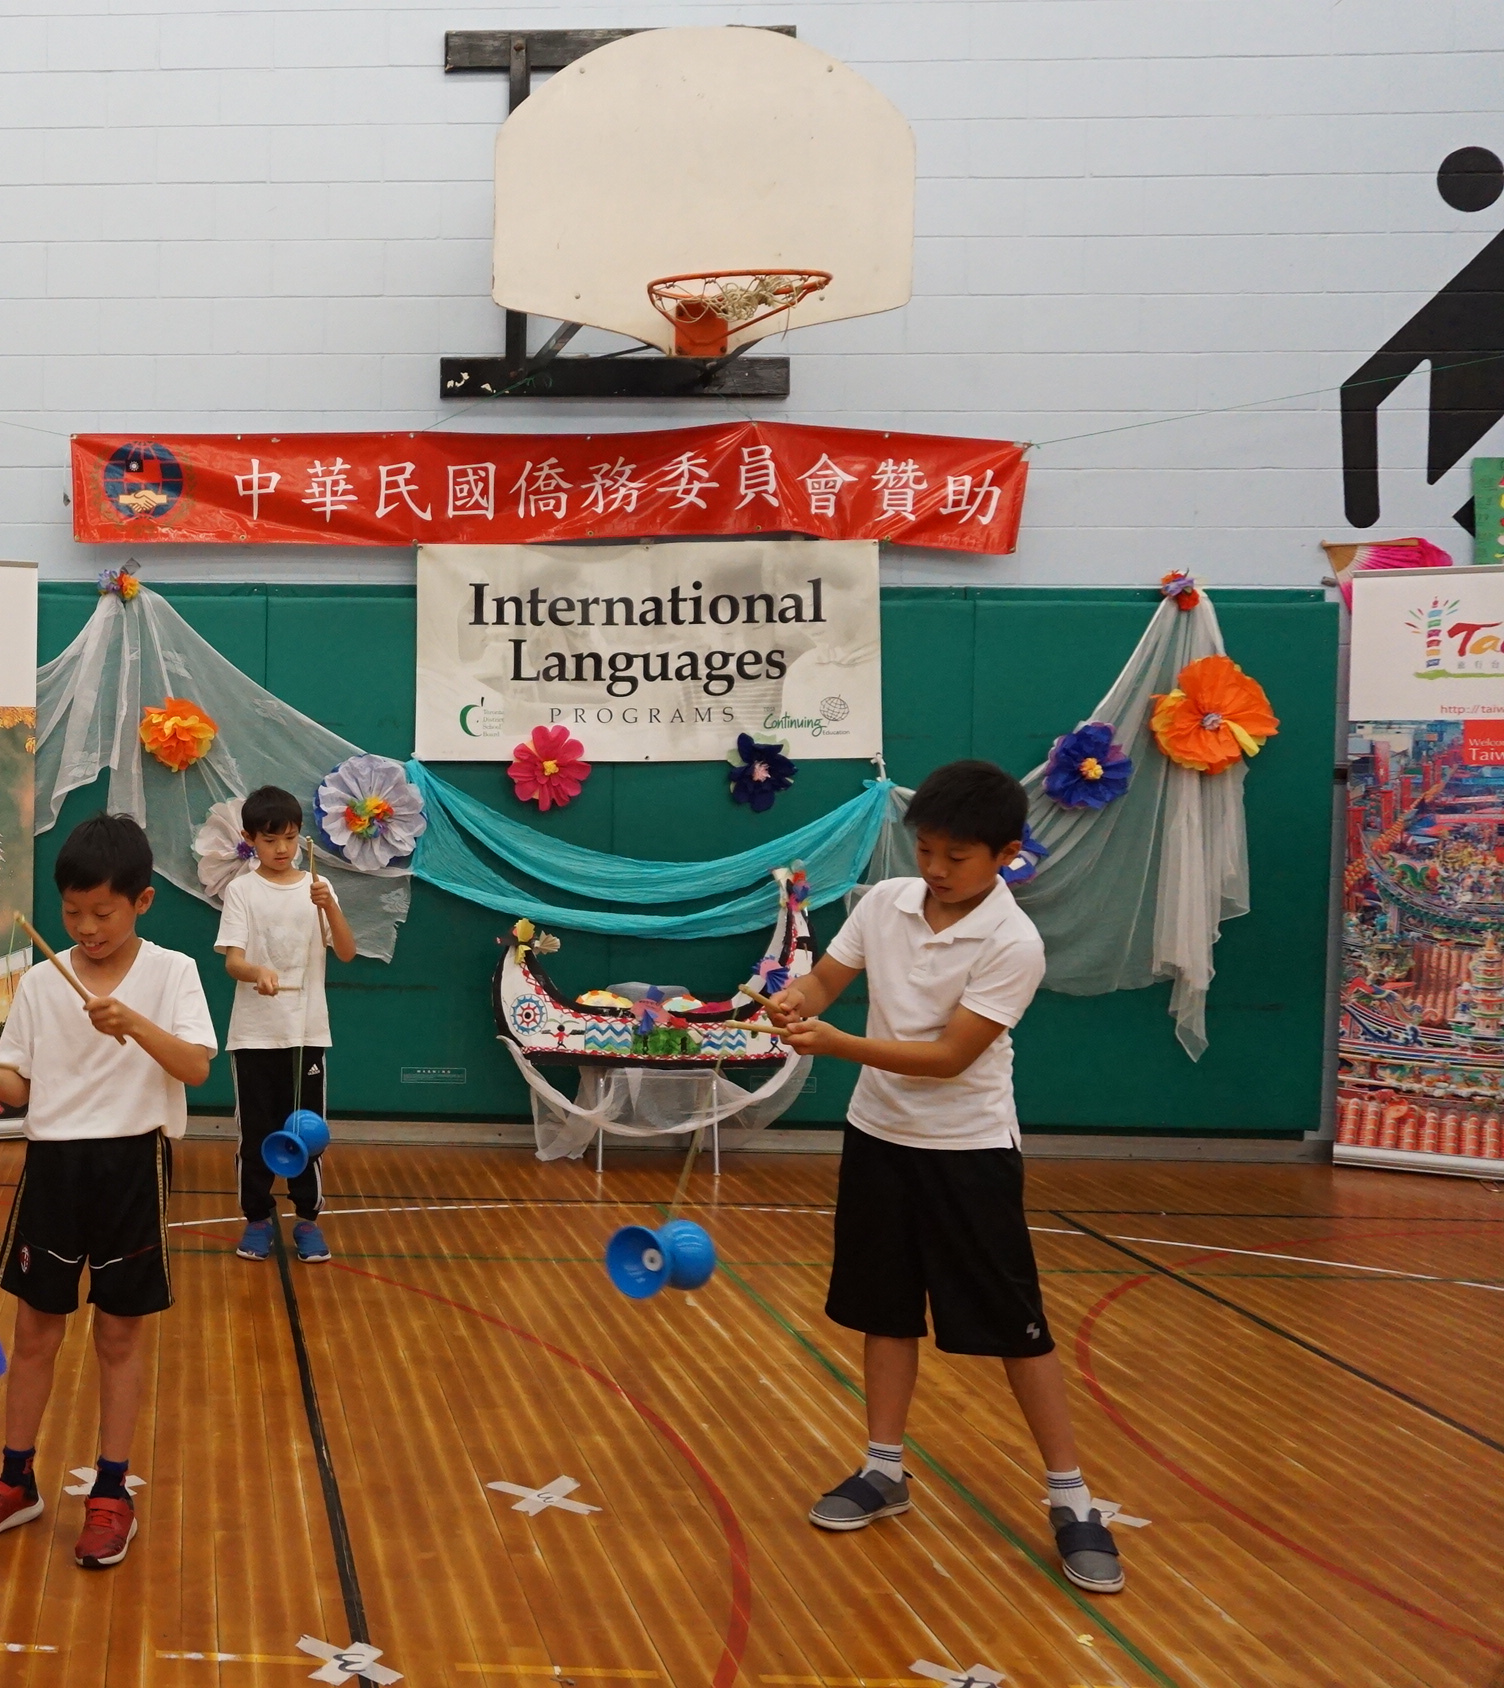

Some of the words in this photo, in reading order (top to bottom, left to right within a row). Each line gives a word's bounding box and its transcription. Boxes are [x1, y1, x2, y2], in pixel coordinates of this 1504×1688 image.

[469, 578, 827, 627] International
[509, 638, 787, 698] Languages
[550, 707, 736, 725] PROGRAMS
[763, 711, 828, 738] Continuing
[1469, 738, 1504, 747] Welco
